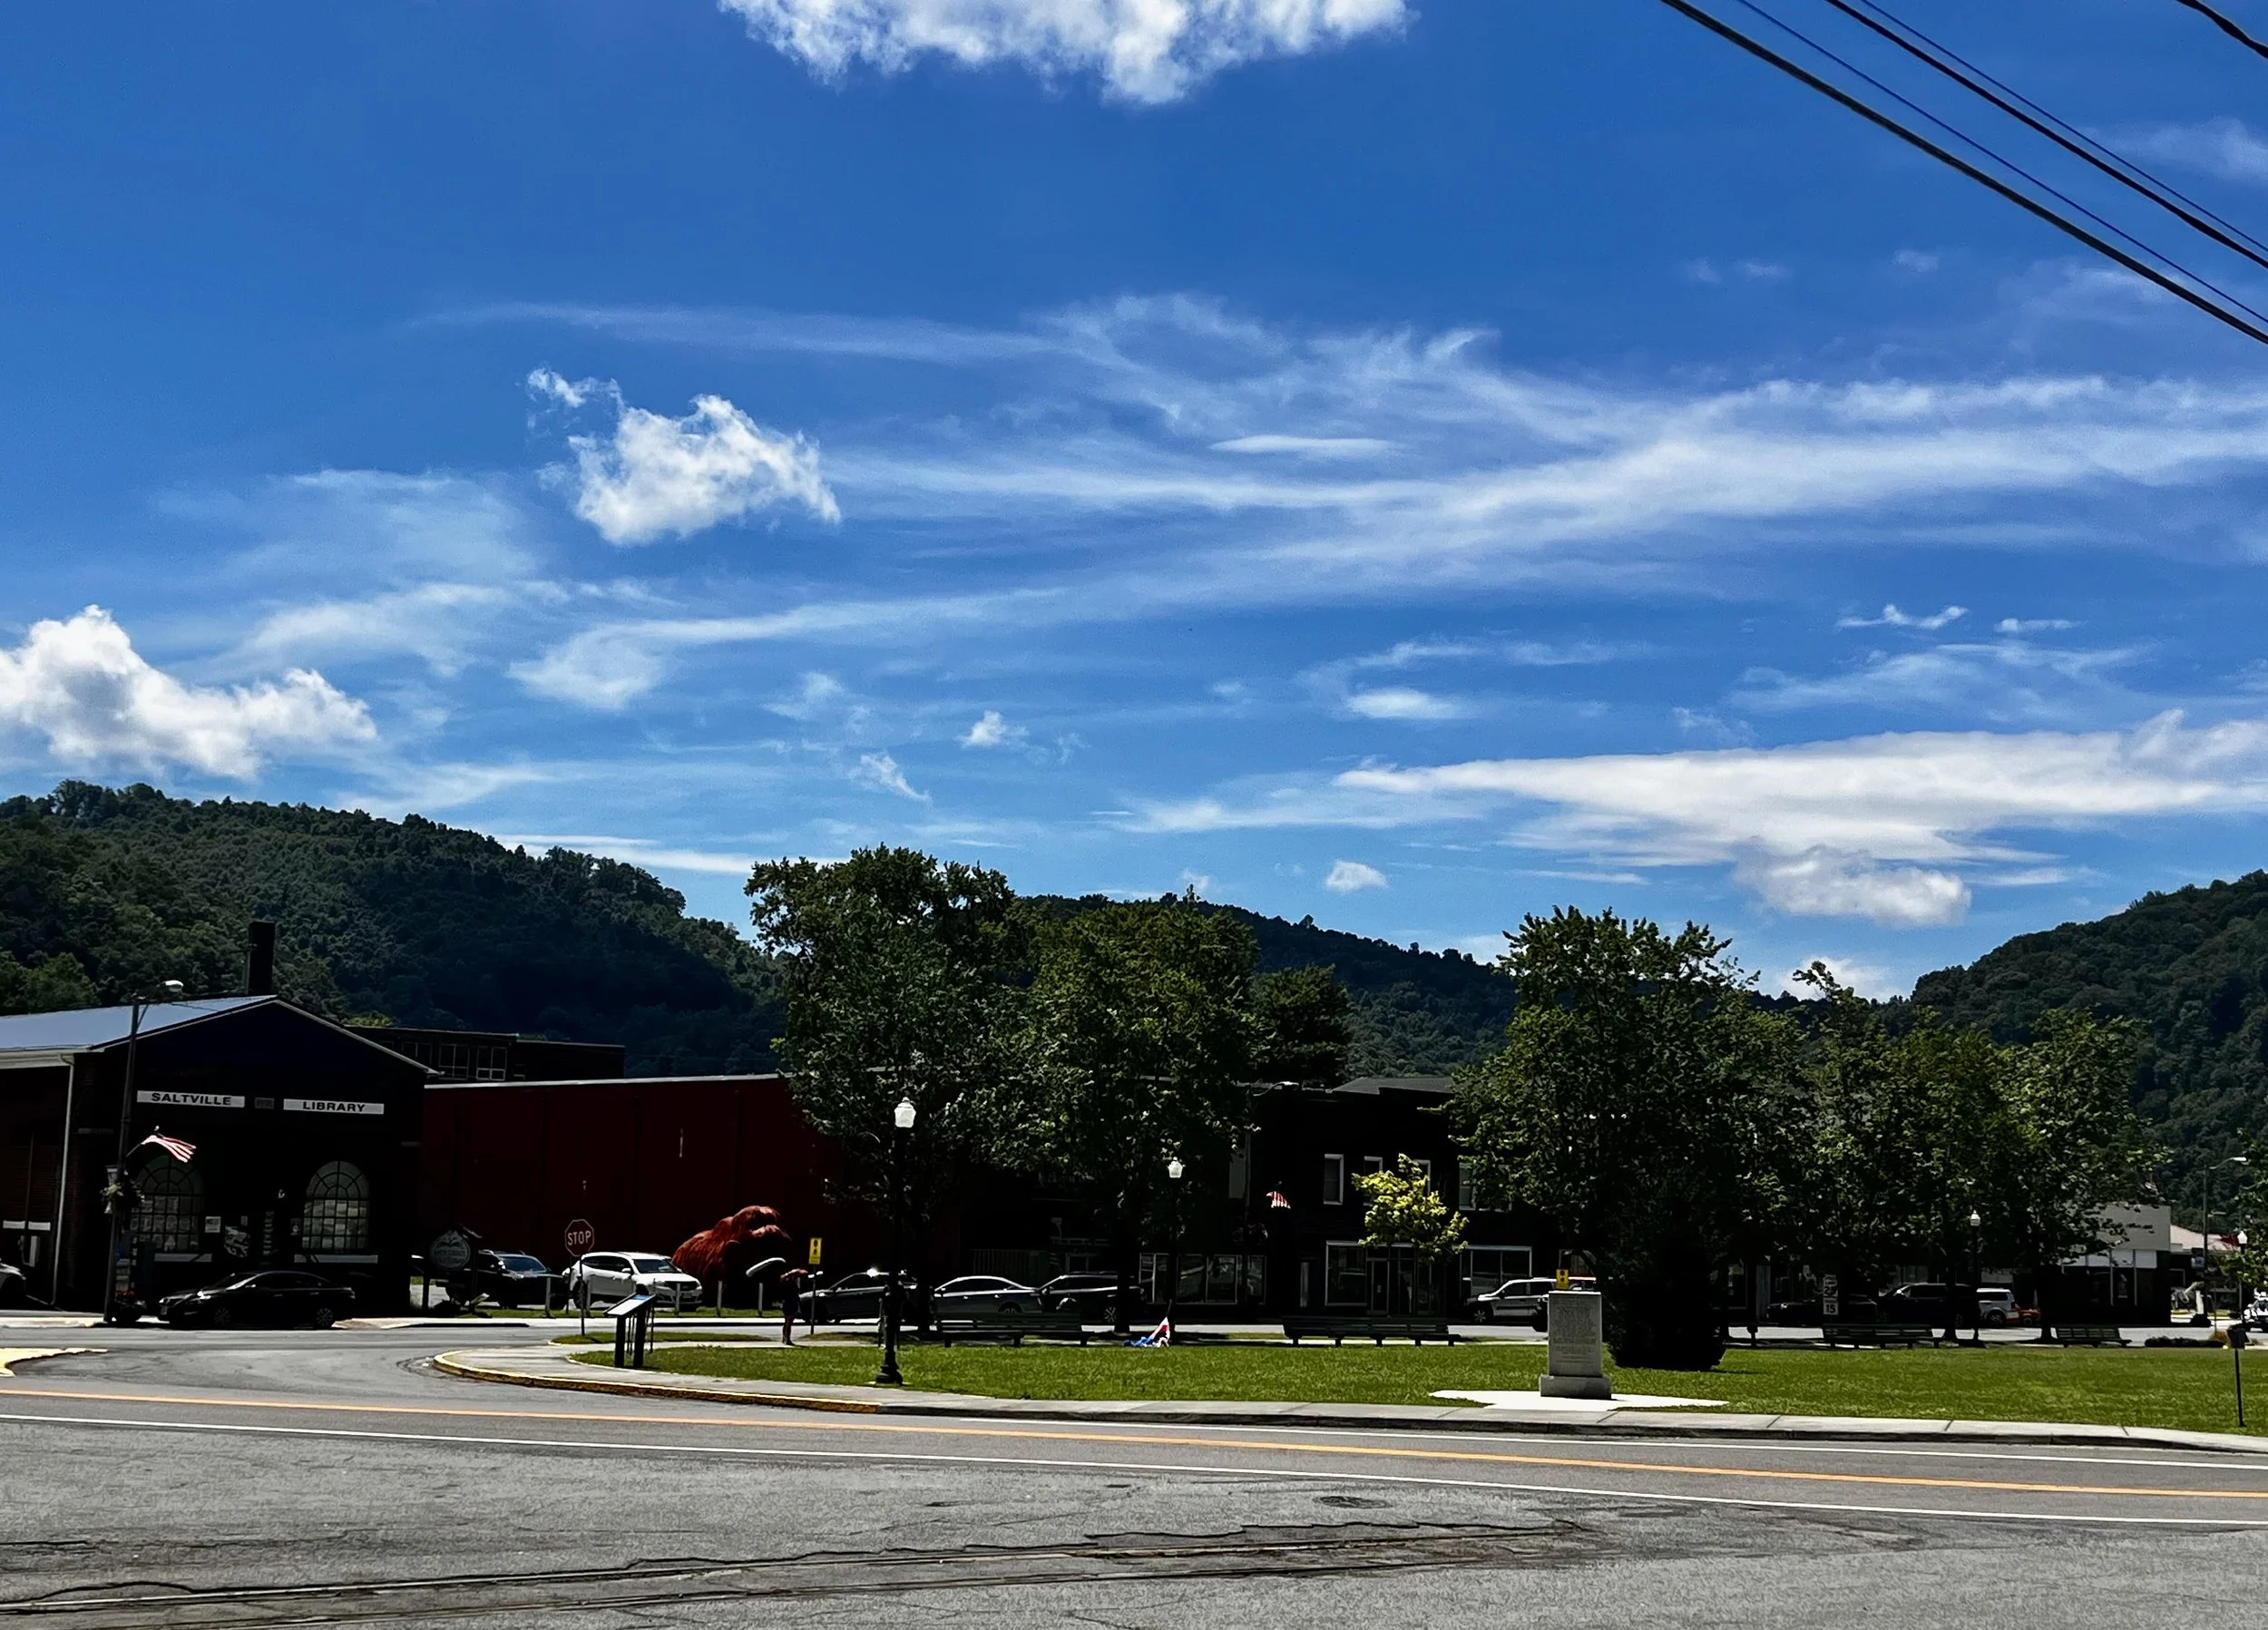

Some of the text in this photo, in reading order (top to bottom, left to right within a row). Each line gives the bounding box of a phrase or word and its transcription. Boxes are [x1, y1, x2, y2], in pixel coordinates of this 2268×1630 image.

[152, 1092, 231, 1106] SALTVILLE
[303, 1101, 365, 1112] LIBRARY
[567, 1230, 591, 1246] STOP
[1823, 1285, 1837, 1296] 25
[1825, 1303, 1836, 1313] 15
